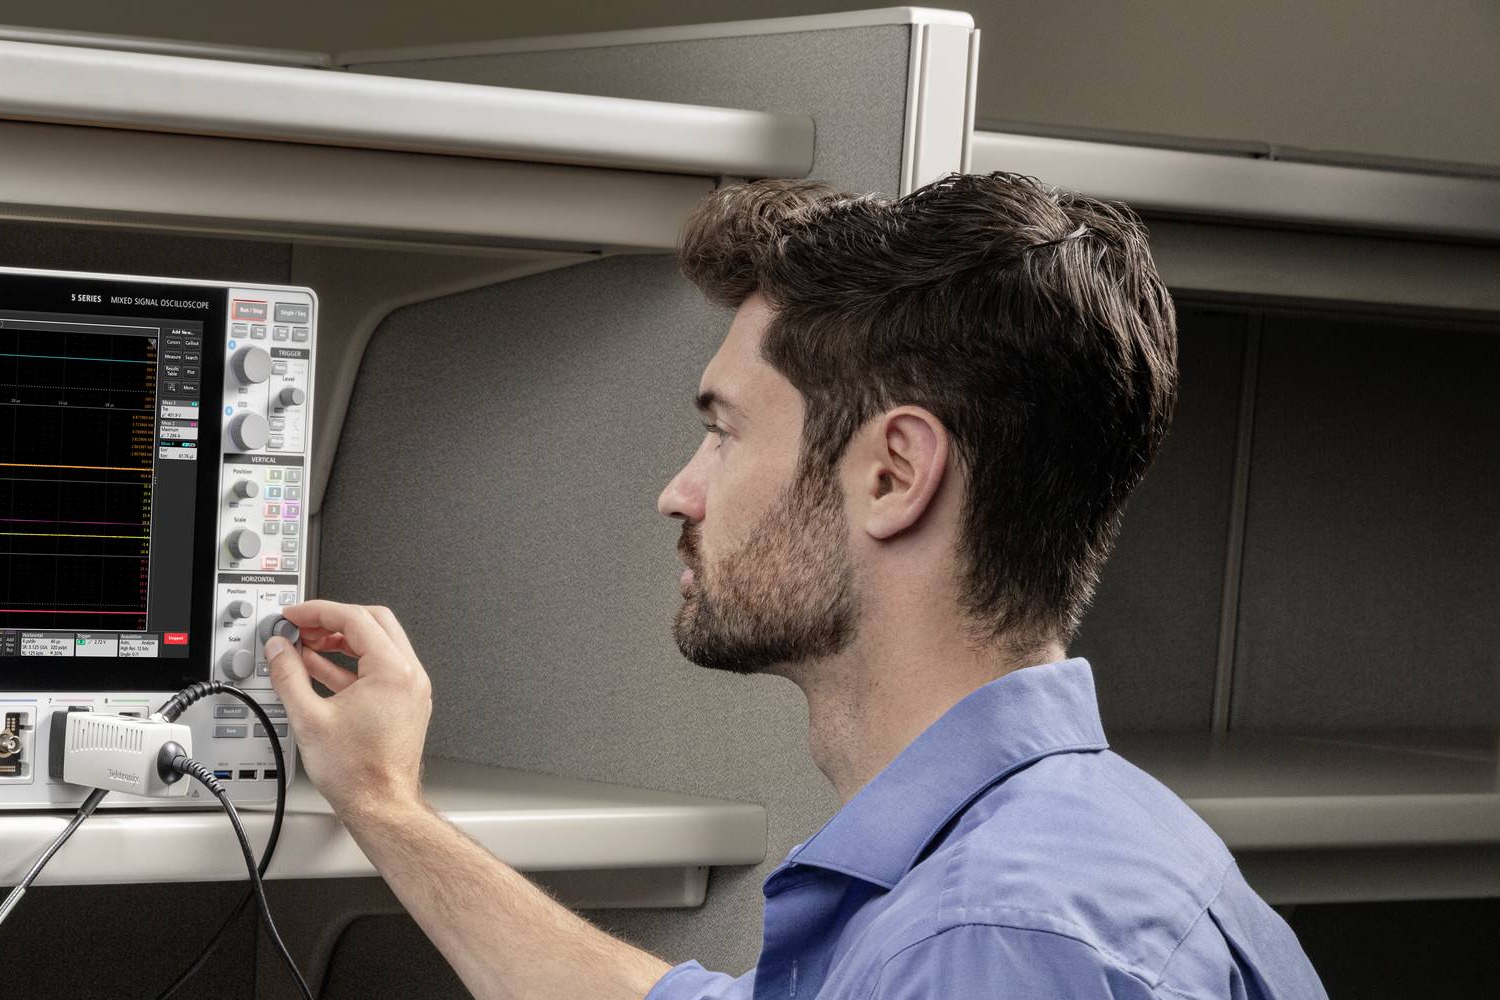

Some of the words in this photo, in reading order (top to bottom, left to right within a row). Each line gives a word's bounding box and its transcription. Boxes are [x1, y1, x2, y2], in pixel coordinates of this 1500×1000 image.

[78, 294, 102, 303] SERIES
[111, 296, 133, 305] MIXED
[134, 297, 159, 307] SIGNAL
[160, 298, 209, 310] OSCILLOSCOPE
[108, 769, 139, 781] Tektronix
